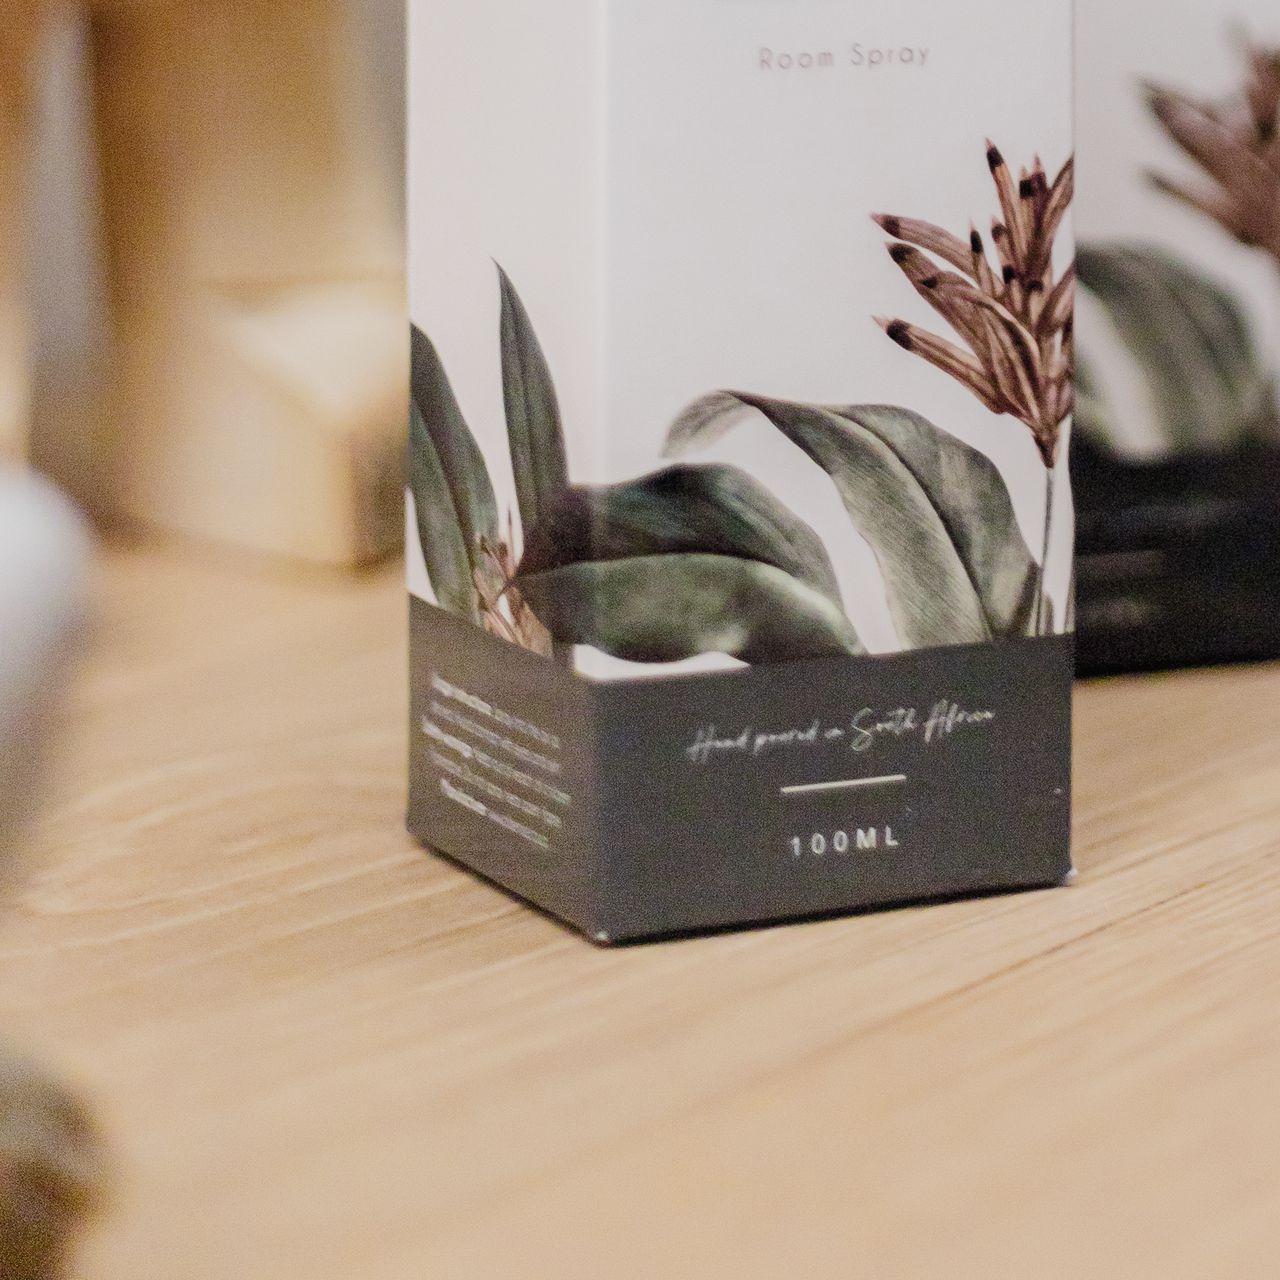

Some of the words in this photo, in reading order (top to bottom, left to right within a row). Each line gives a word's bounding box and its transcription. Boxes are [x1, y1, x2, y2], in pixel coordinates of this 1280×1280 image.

[760, 47, 835, 72] Room
[851, 42, 931, 70] Spray
[790, 824, 899, 857] 100ML
